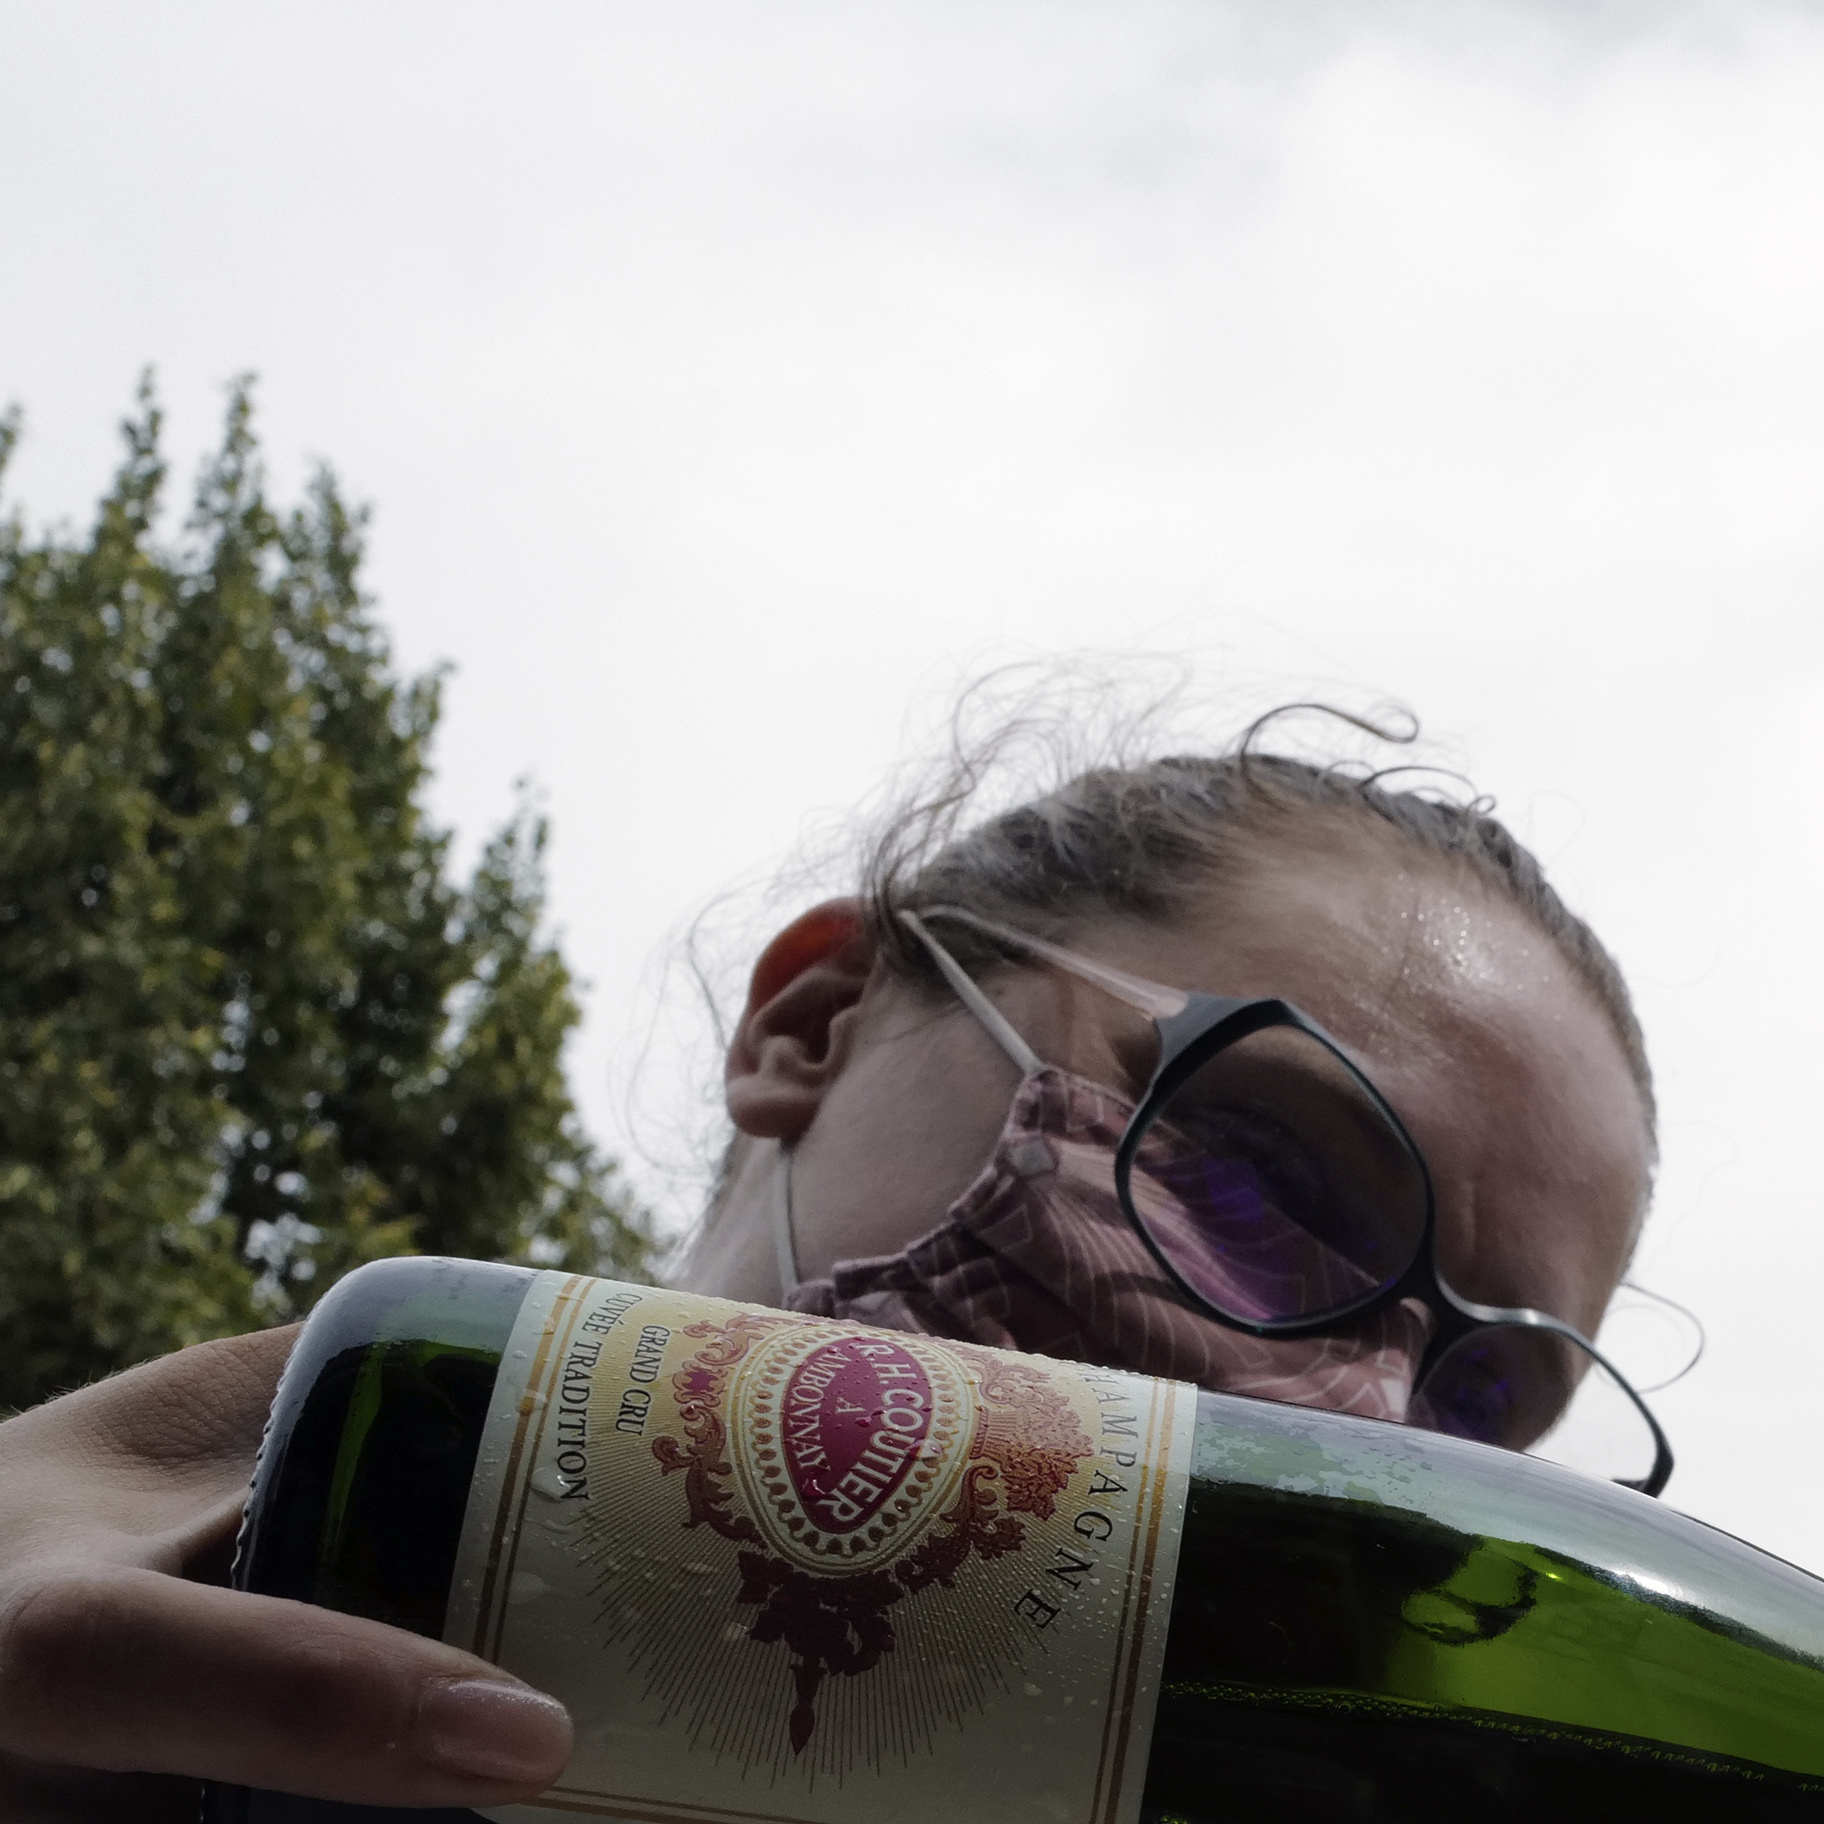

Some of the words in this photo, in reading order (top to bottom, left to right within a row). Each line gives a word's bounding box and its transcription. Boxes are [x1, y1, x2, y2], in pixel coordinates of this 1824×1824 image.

[581, 1292, 643, 1335] CUVÉE
[629, 1325, 671, 1384] GRAND
[557, 1341, 603, 1500] TRADITION
[614, 1389, 651, 1437] CRU
[787, 1348, 852, 1472] AMBONNAY
[817, 1388, 924, 1521] COUTIER
[1013, 1372, 1138, 1630] HAMPAGNE
